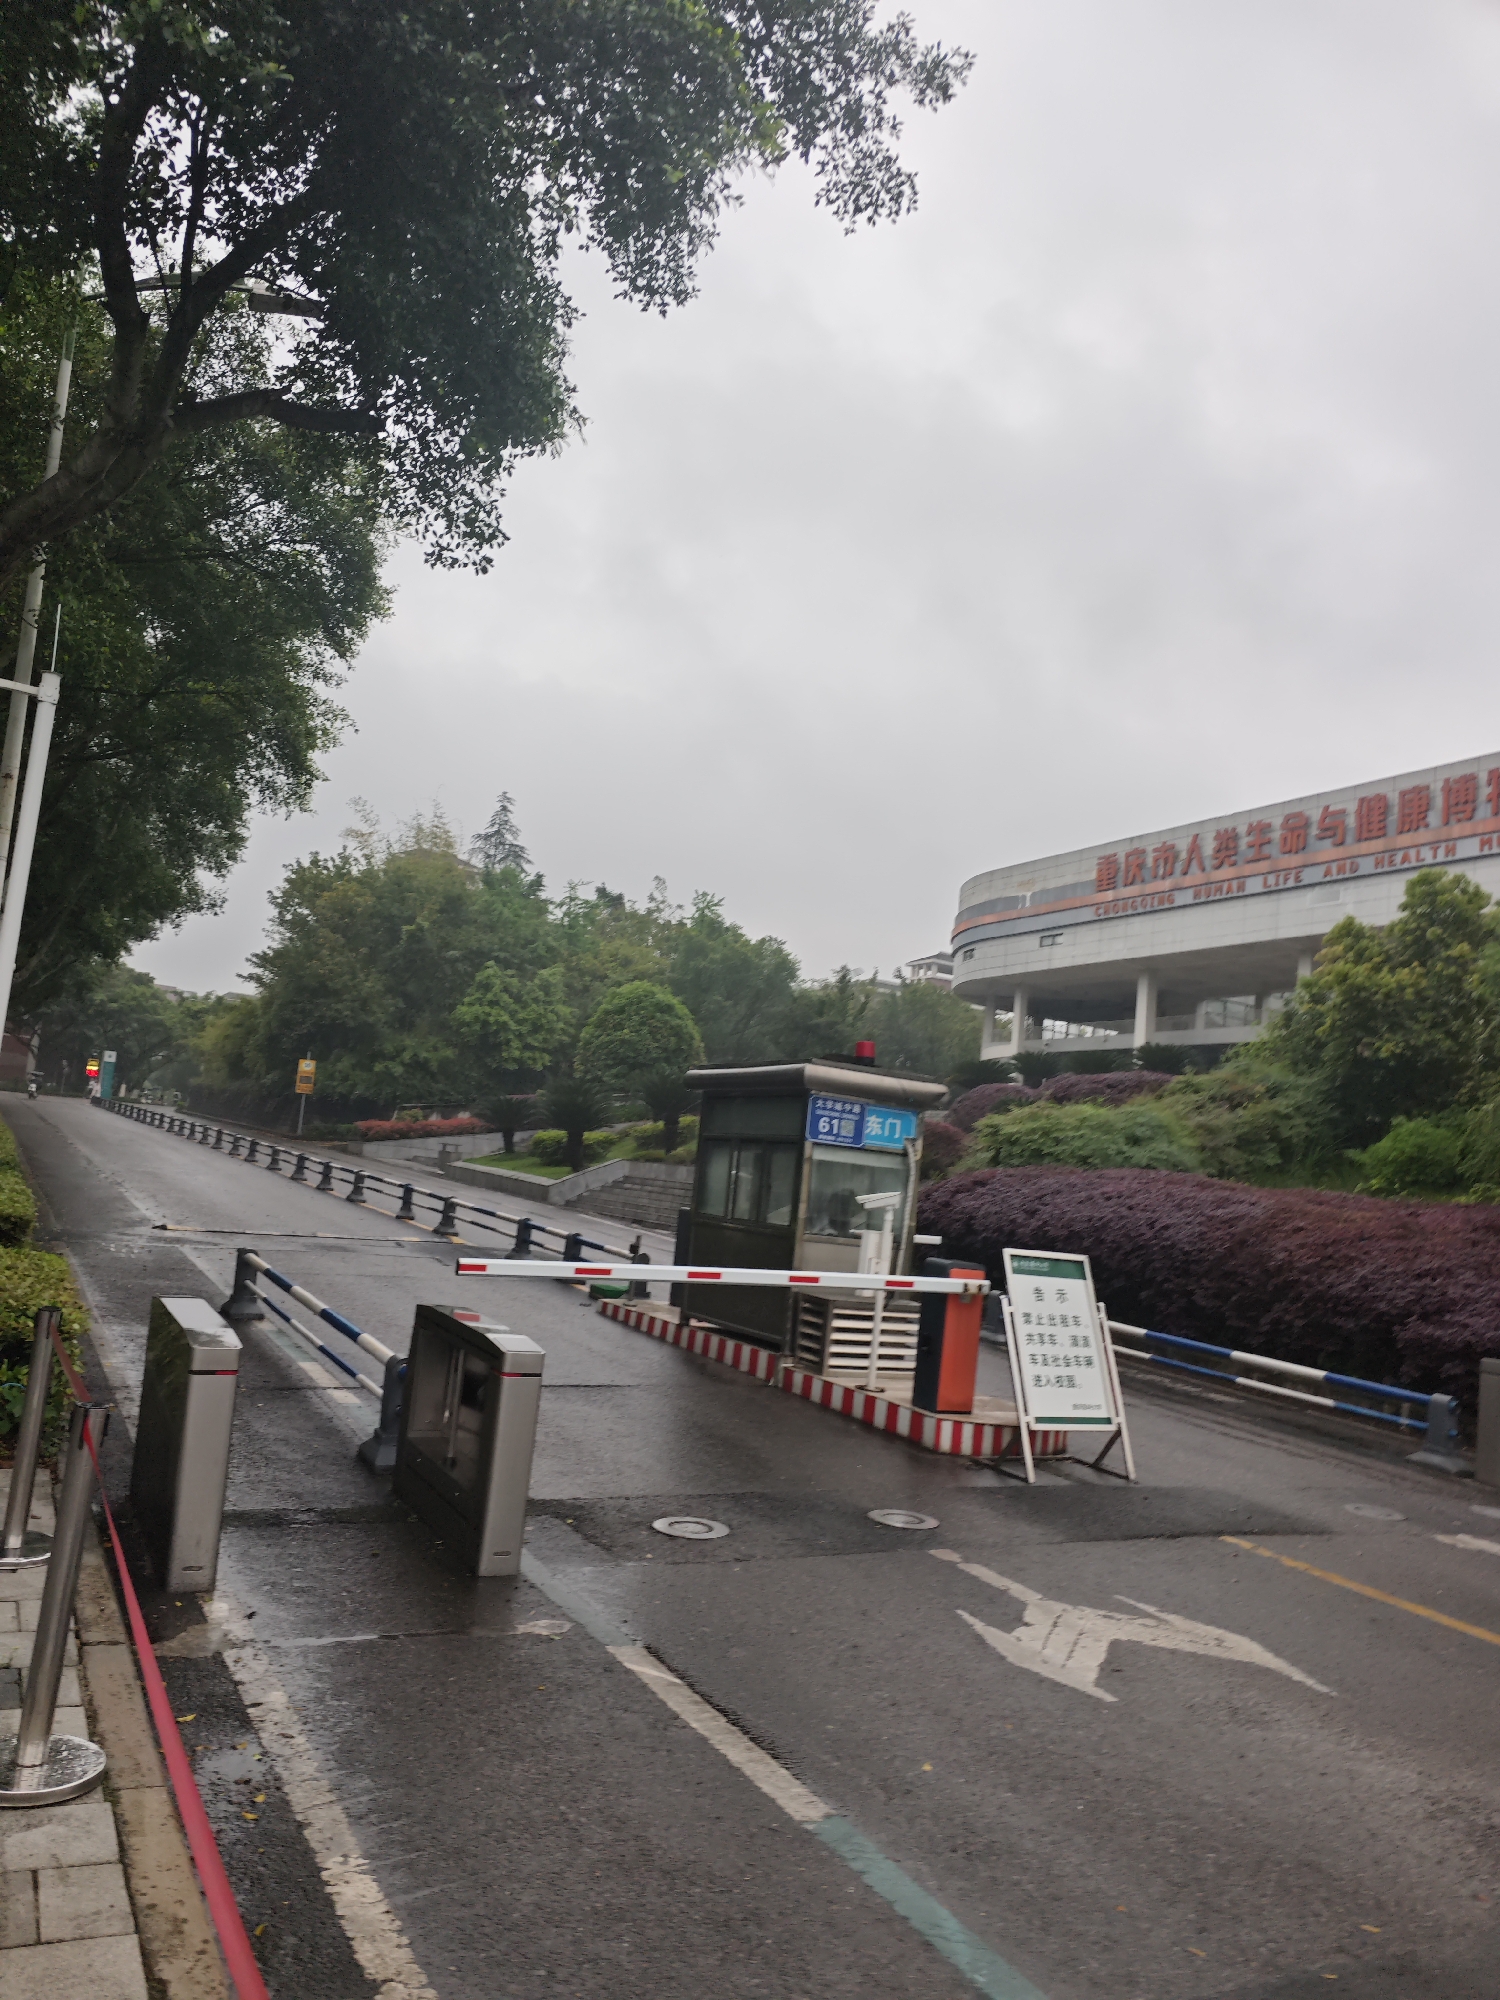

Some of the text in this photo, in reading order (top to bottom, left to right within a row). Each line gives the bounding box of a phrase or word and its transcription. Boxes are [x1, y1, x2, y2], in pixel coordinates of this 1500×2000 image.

[1094, 893, 1176, 918] CHONGQING
[1192, 880, 1247, 901] HUMAN
[1262, 869, 1304, 889] LIFE
[1323, 861, 1360, 879] AND
[1374, 843, 1457, 870] HEALTH
[818, 1116, 840, 1135] 61
[865, 1115, 902, 1139] 东门
